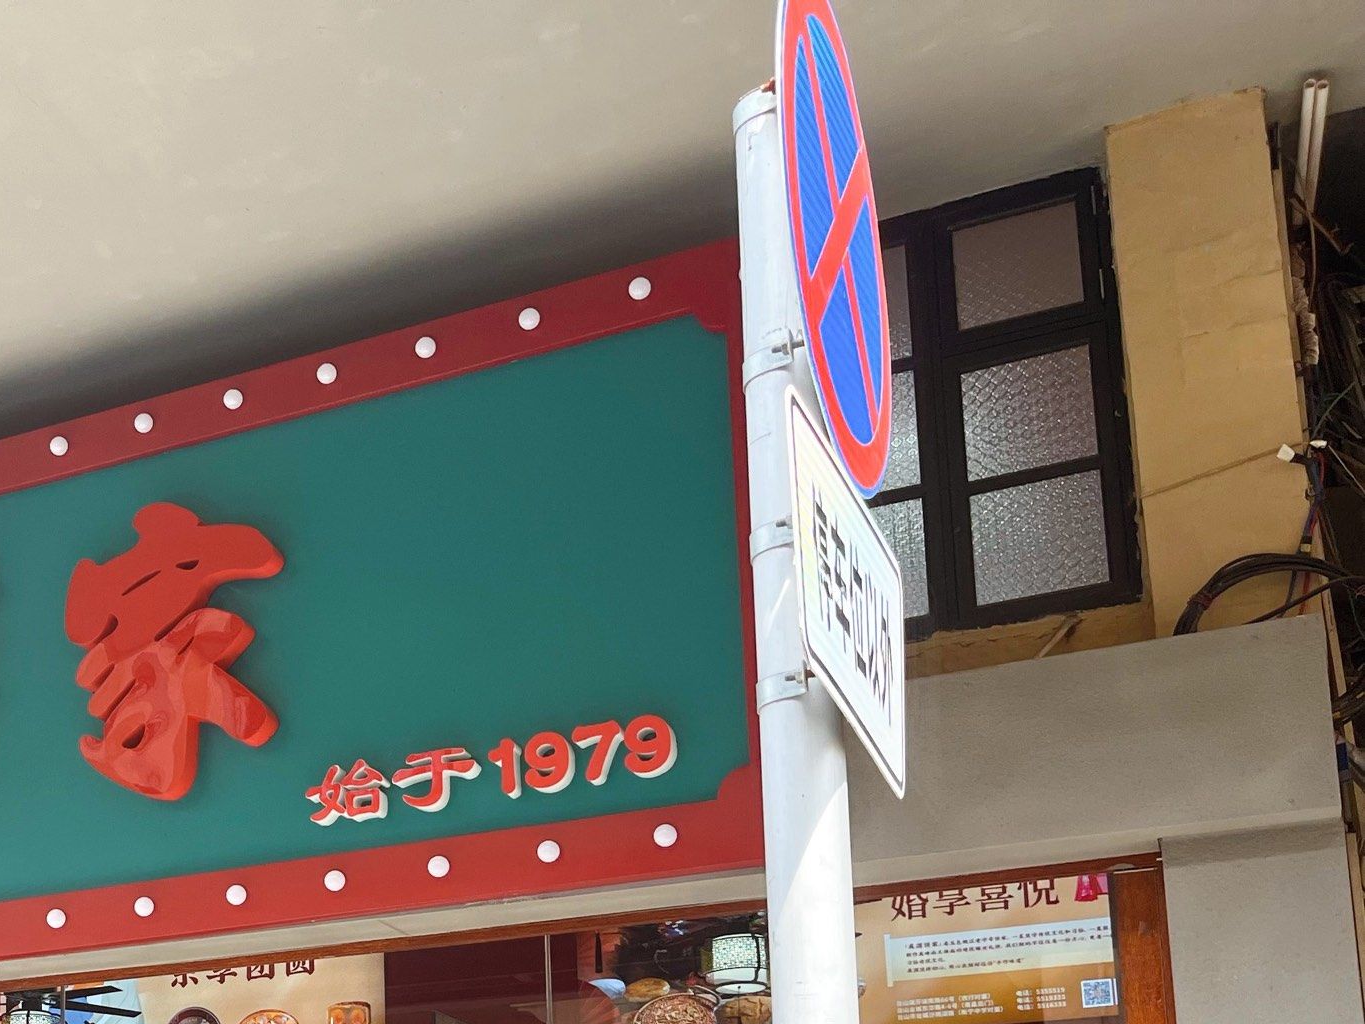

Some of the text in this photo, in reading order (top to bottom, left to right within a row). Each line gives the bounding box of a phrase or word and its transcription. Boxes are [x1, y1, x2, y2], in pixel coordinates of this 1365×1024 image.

[812, 483, 893, 726] 停车位以外
[306, 714, 677, 827] 始于1979
